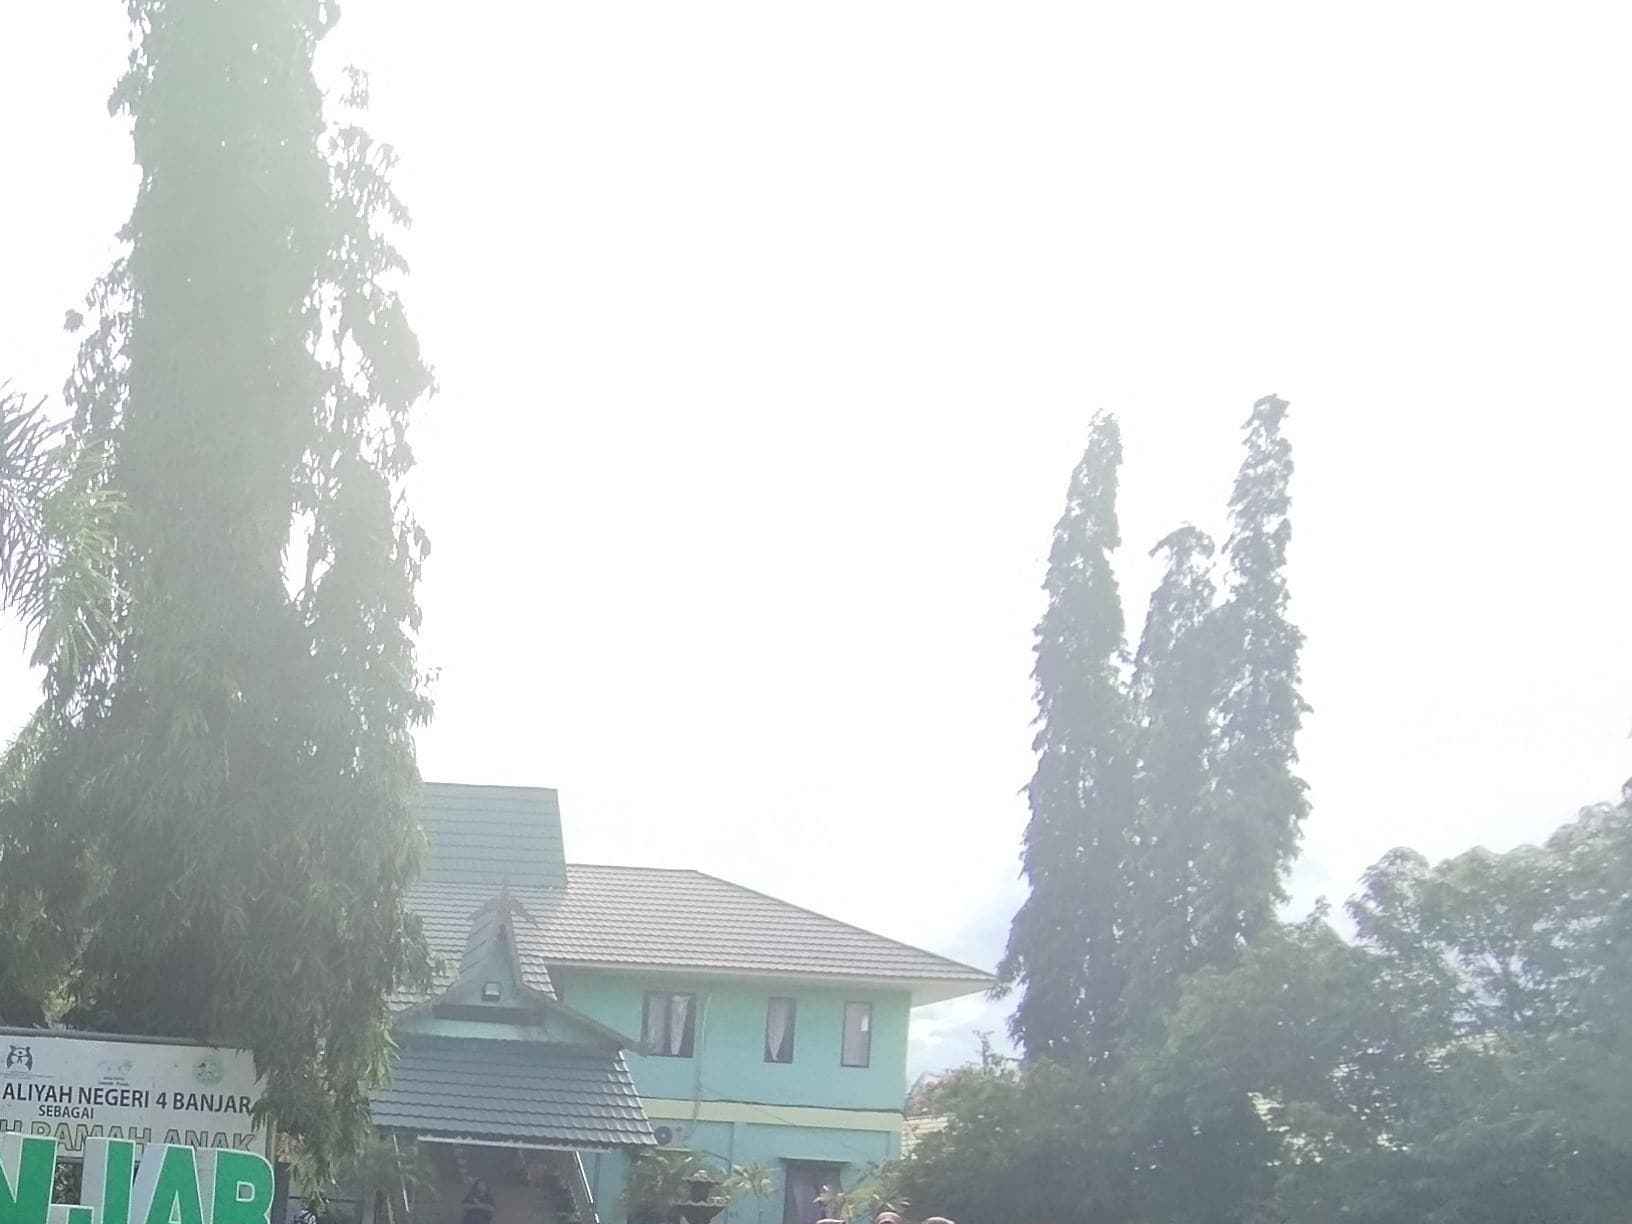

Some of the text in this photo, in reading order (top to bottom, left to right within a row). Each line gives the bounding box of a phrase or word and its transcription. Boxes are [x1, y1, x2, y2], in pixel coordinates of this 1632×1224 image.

[2, 1083, 73, 1104] ALIYAH
[78, 1086, 151, 1109] NEGERI
[156, 1091, 168, 1110] 4
[173, 1092, 252, 1115] BANJAR
[38, 1104, 95, 1119] SEBAGAI
